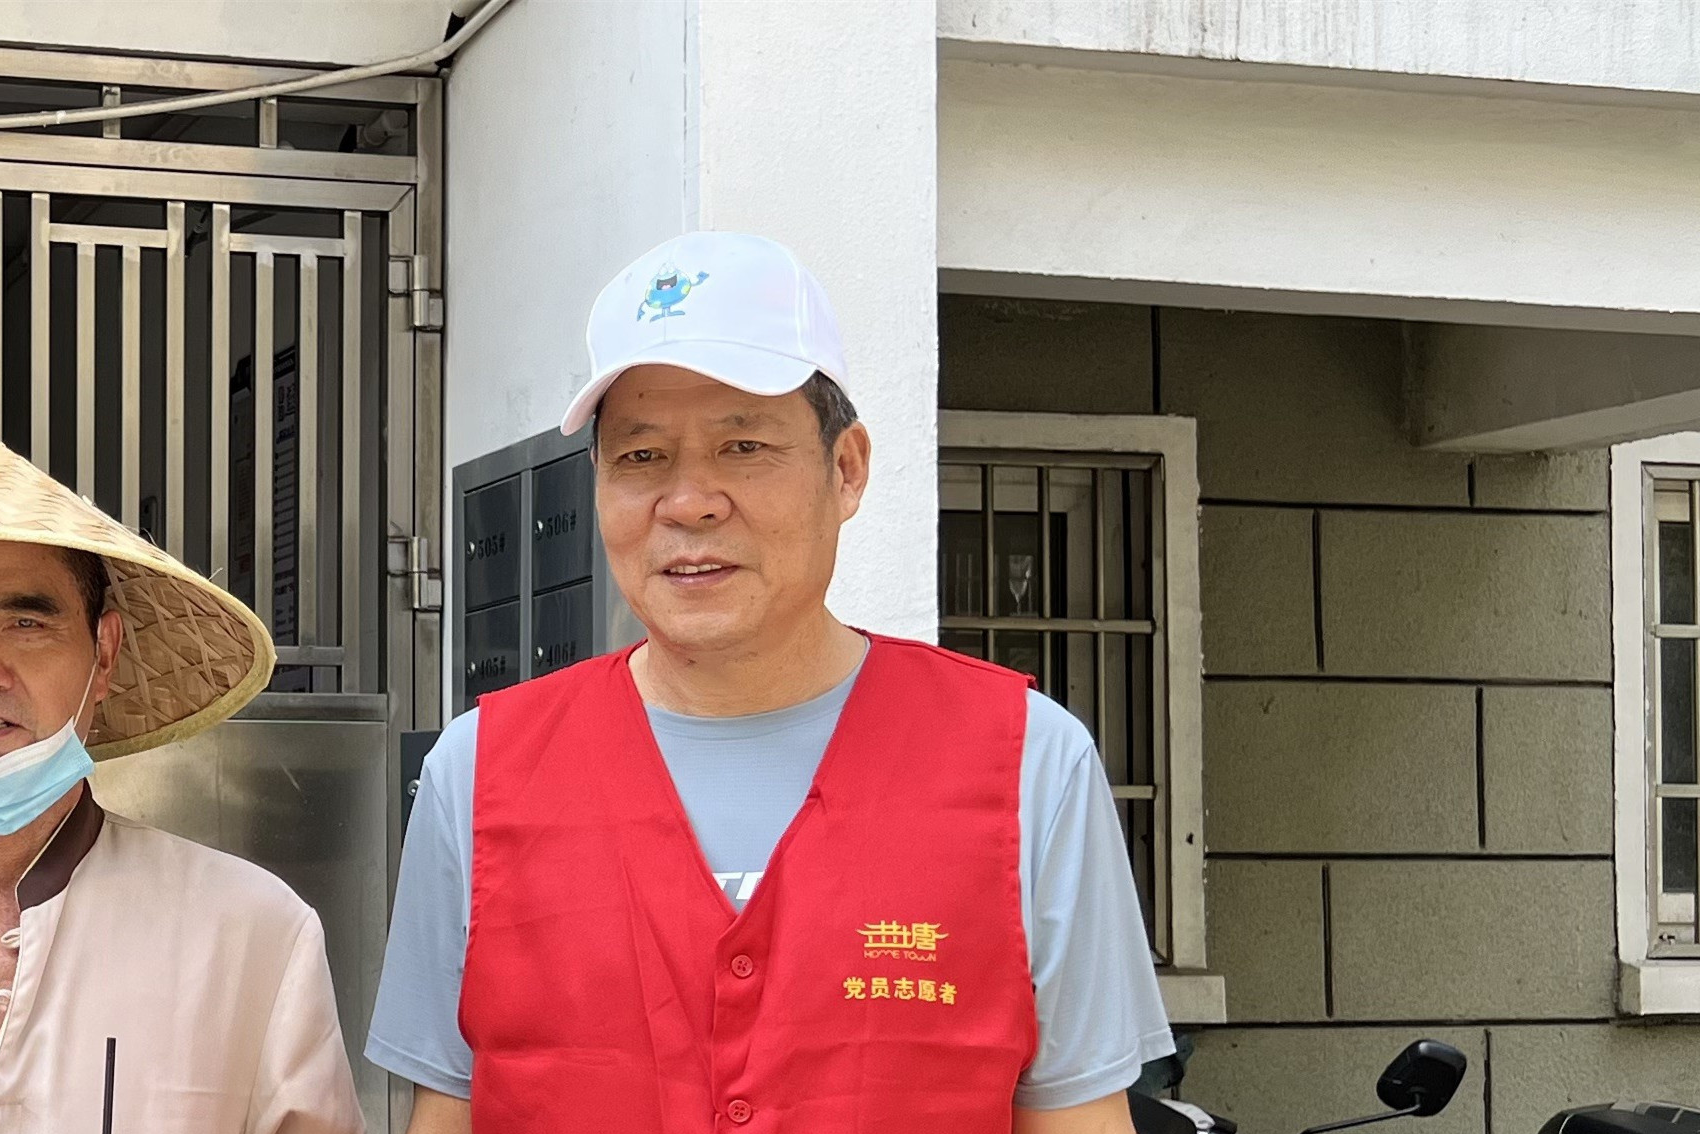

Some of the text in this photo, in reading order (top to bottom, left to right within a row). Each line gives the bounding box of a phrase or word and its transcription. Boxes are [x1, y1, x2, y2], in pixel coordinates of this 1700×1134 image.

[546, 509, 577, 540] 506#
[477, 532, 506, 560] 505#
[546, 640, 577, 667] 406#
[863, 949, 901, 960] HOME
[842, 976, 958, 1006] 党员志愿者
